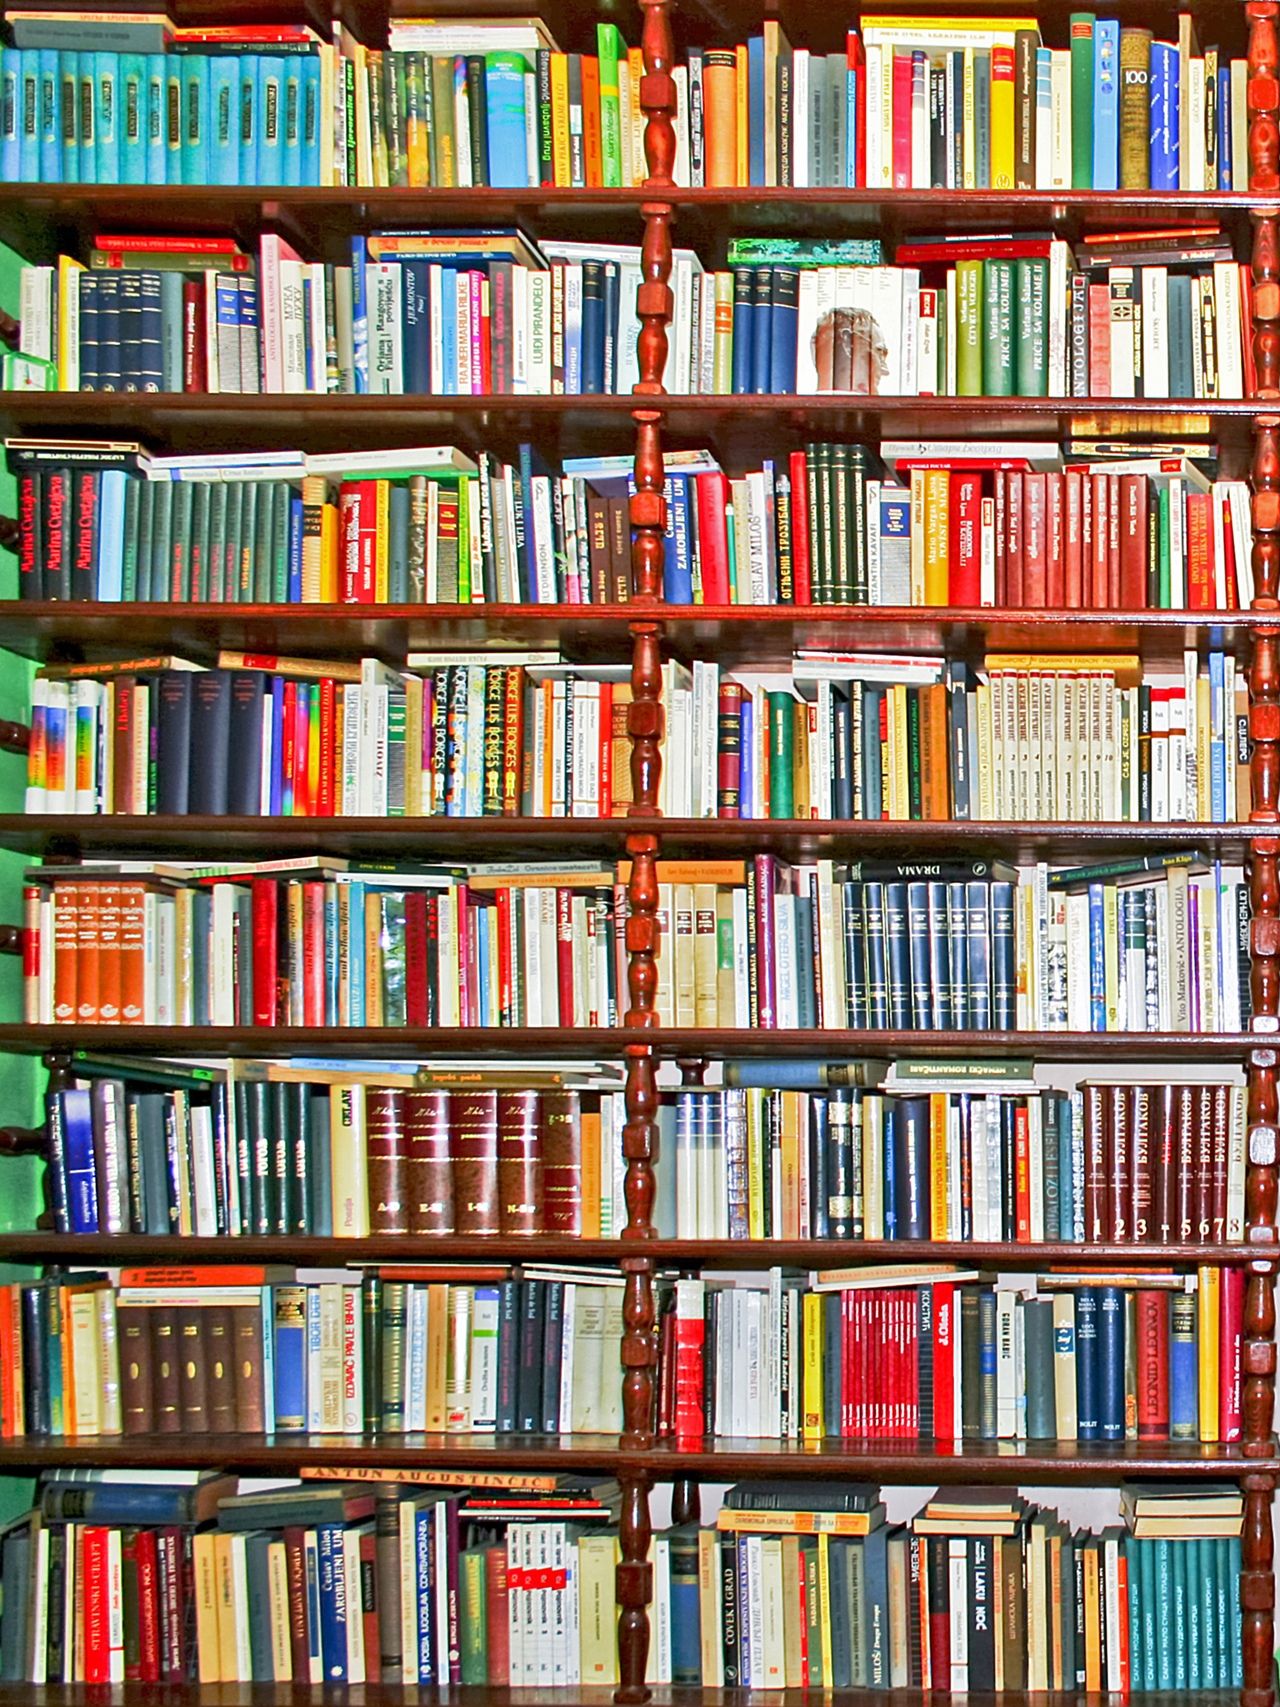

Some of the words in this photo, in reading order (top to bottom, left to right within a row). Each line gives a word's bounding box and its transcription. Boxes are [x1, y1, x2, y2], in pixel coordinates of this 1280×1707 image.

[1125, 71, 1148, 84] 100
[457, 282, 468, 311] RILKE
[674, 479, 684, 496] UM
[342, 1090, 353, 1126] CELAN
[343, 1293, 354, 1325] BIHALI
[343, 1329, 354, 1356] PAVLE
[342, 1359, 354, 1398] IZDAVAČ
[313, 1467, 383, 1479] ANTUN
[333, 1530, 344, 1547] UM
[724, 1568, 734, 1600] GRAD
